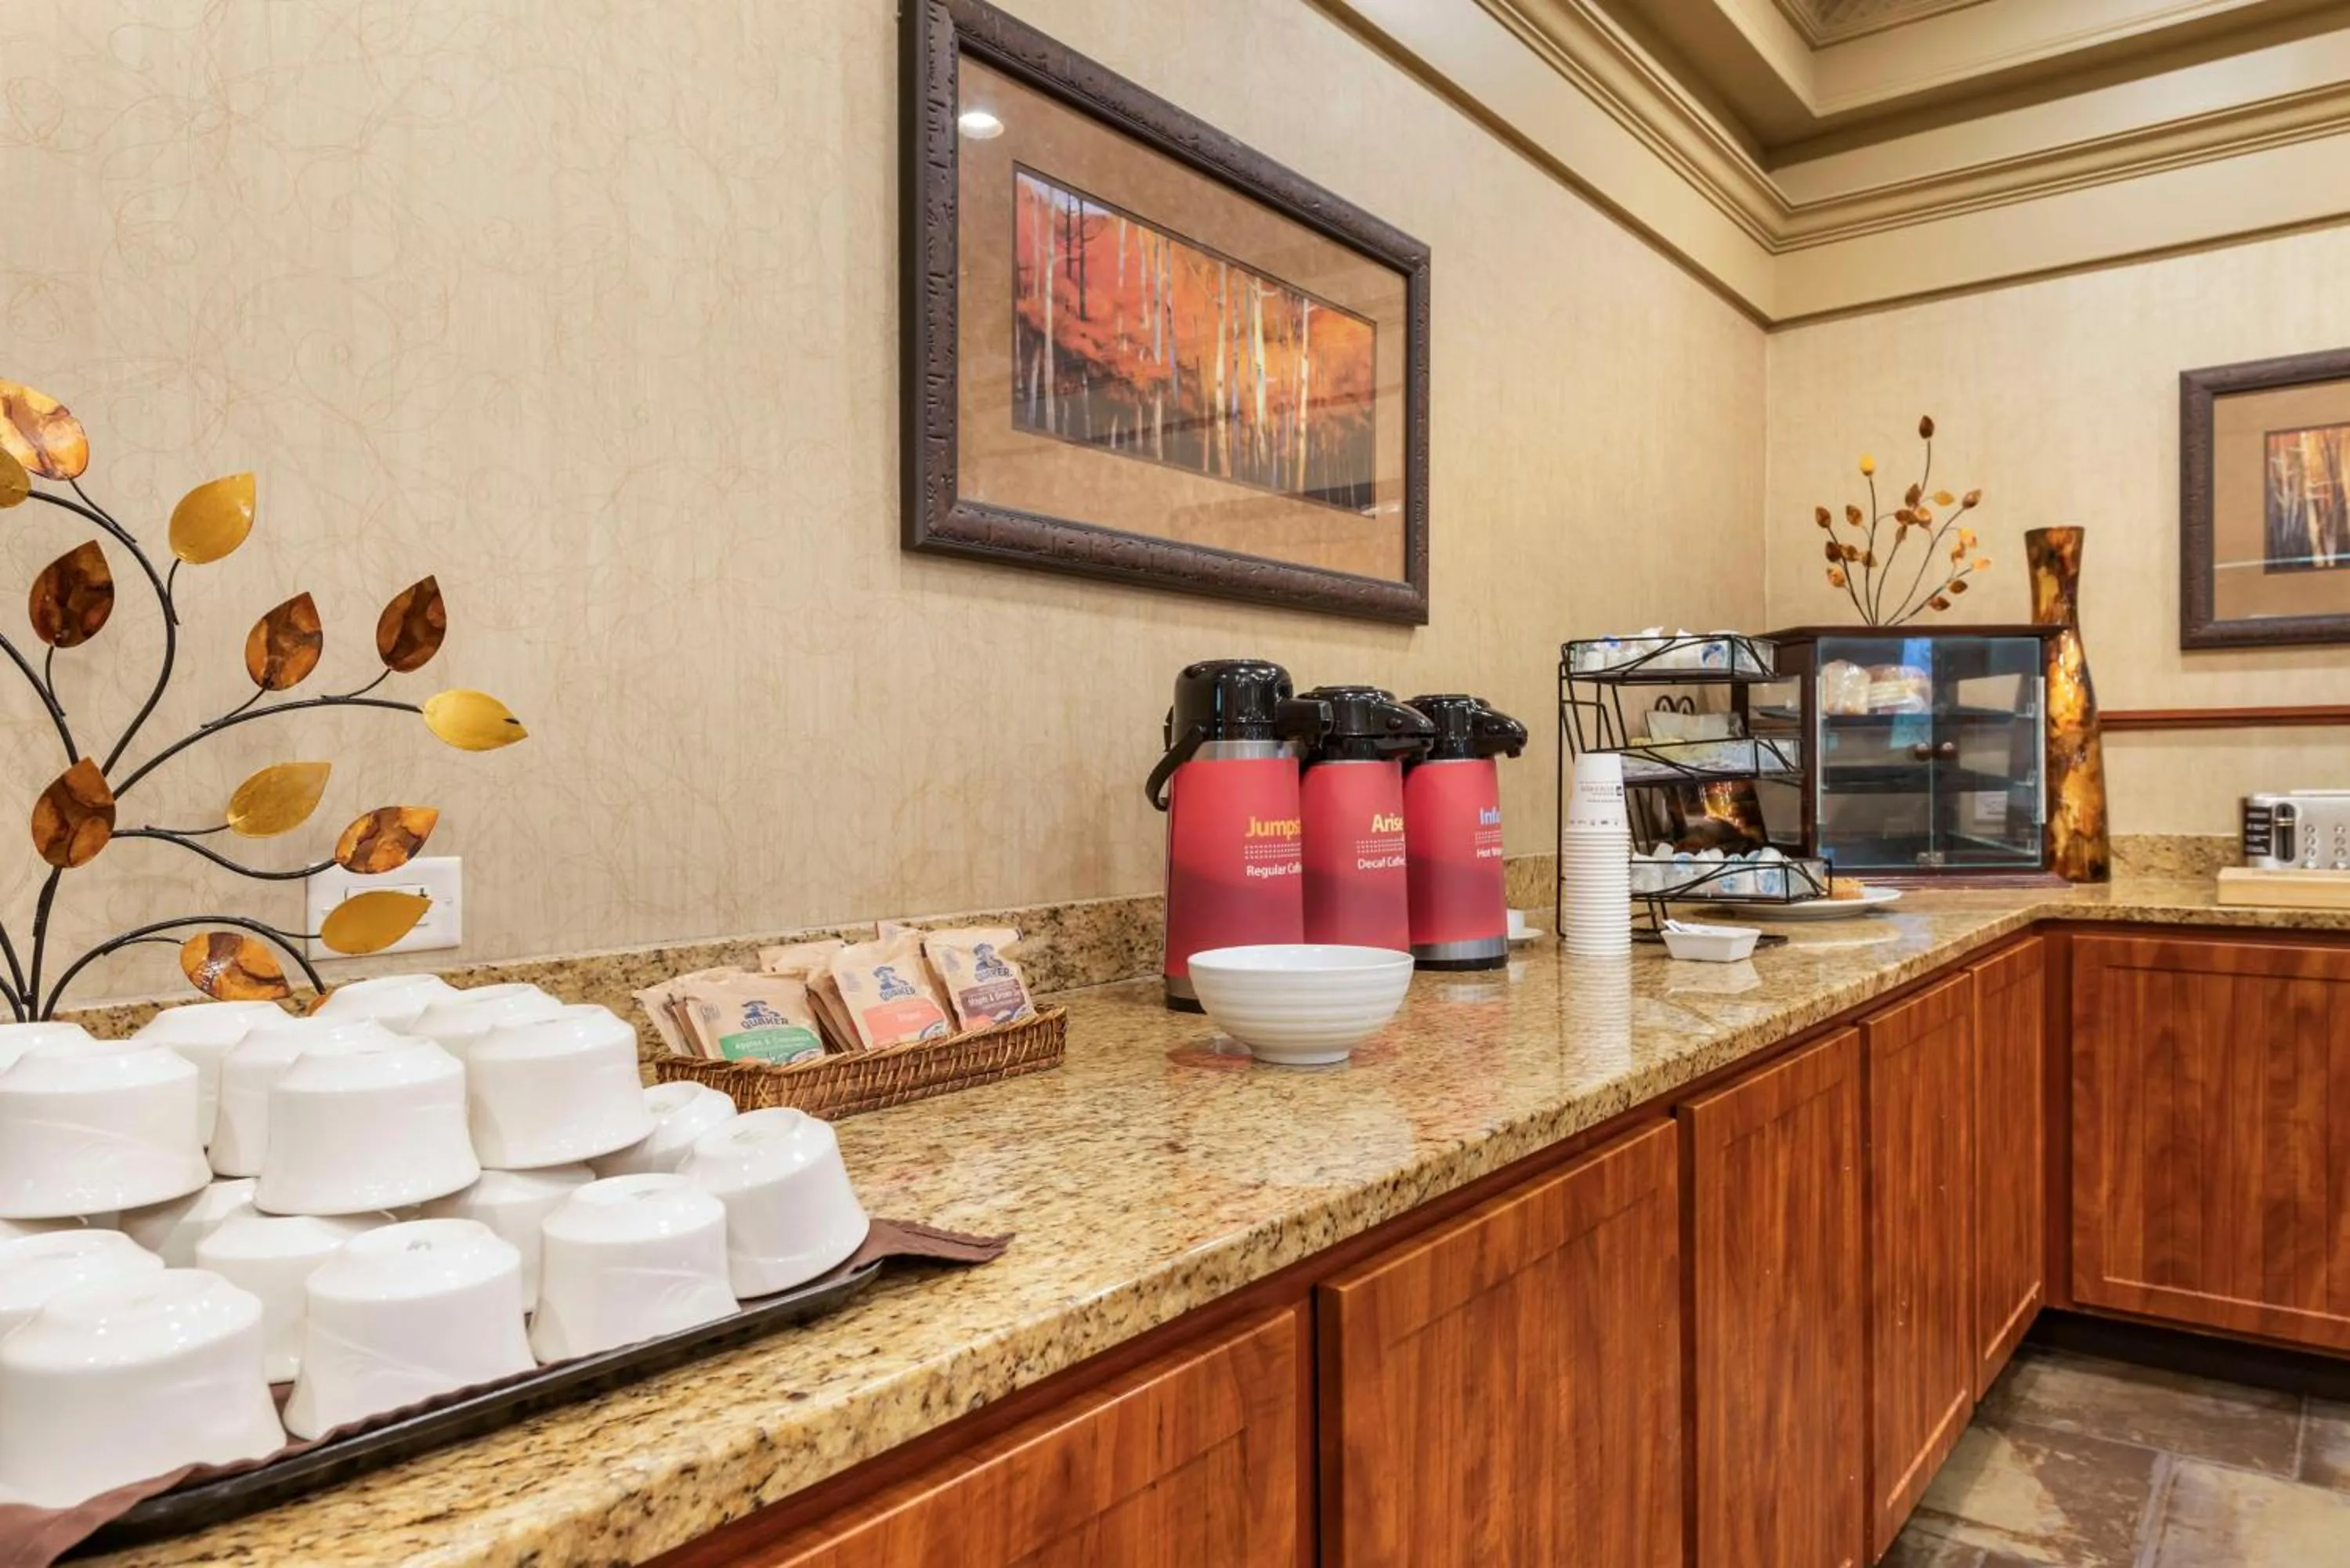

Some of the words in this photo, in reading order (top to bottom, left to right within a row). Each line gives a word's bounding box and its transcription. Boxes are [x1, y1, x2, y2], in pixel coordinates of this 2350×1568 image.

[1358, 857, 1386, 870] Decaf
[1246, 864, 1286, 879] Regular
[740, 1017, 789, 1029] QUAKER
